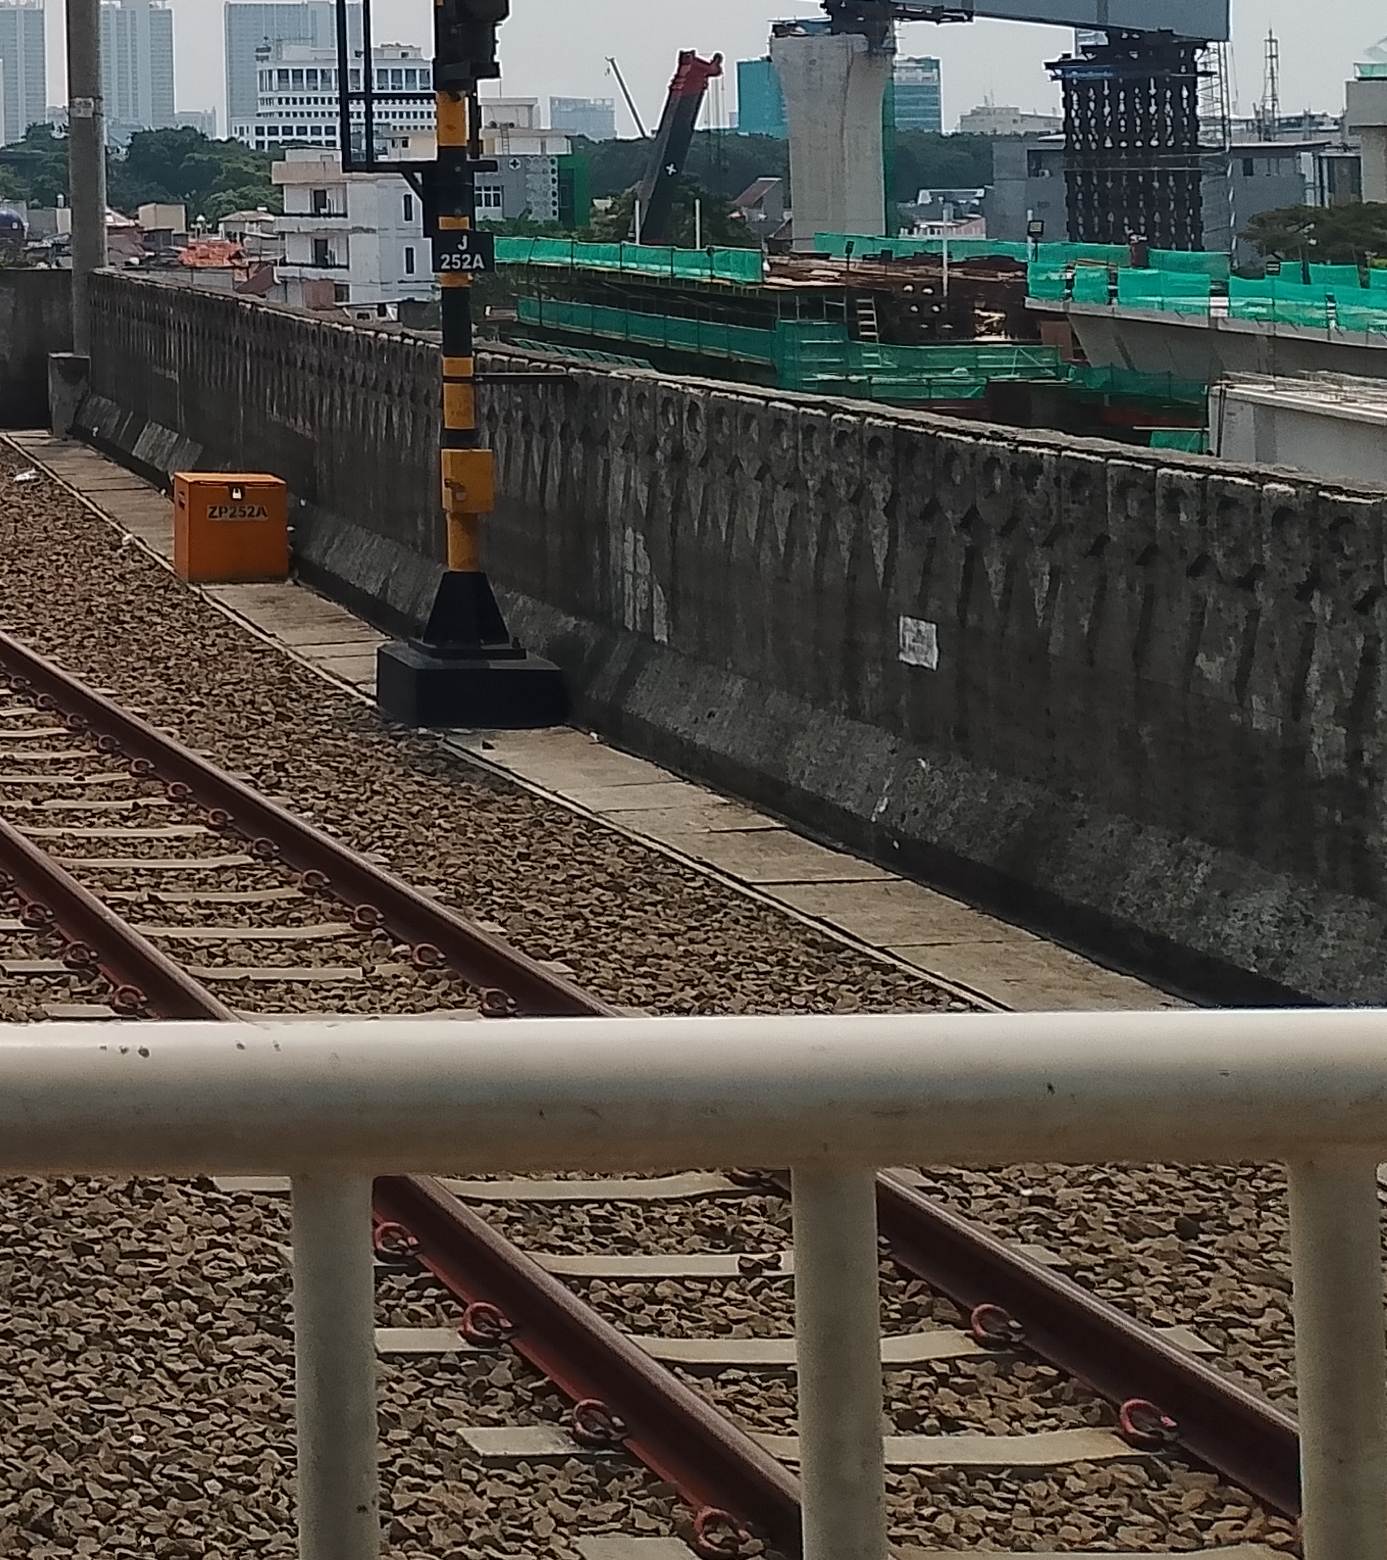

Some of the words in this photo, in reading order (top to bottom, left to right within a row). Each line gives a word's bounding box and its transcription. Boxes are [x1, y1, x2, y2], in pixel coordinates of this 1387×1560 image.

[457, 235, 468, 251] J
[440, 253, 485, 270] 252A
[208, 505, 268, 519] ZP252A
